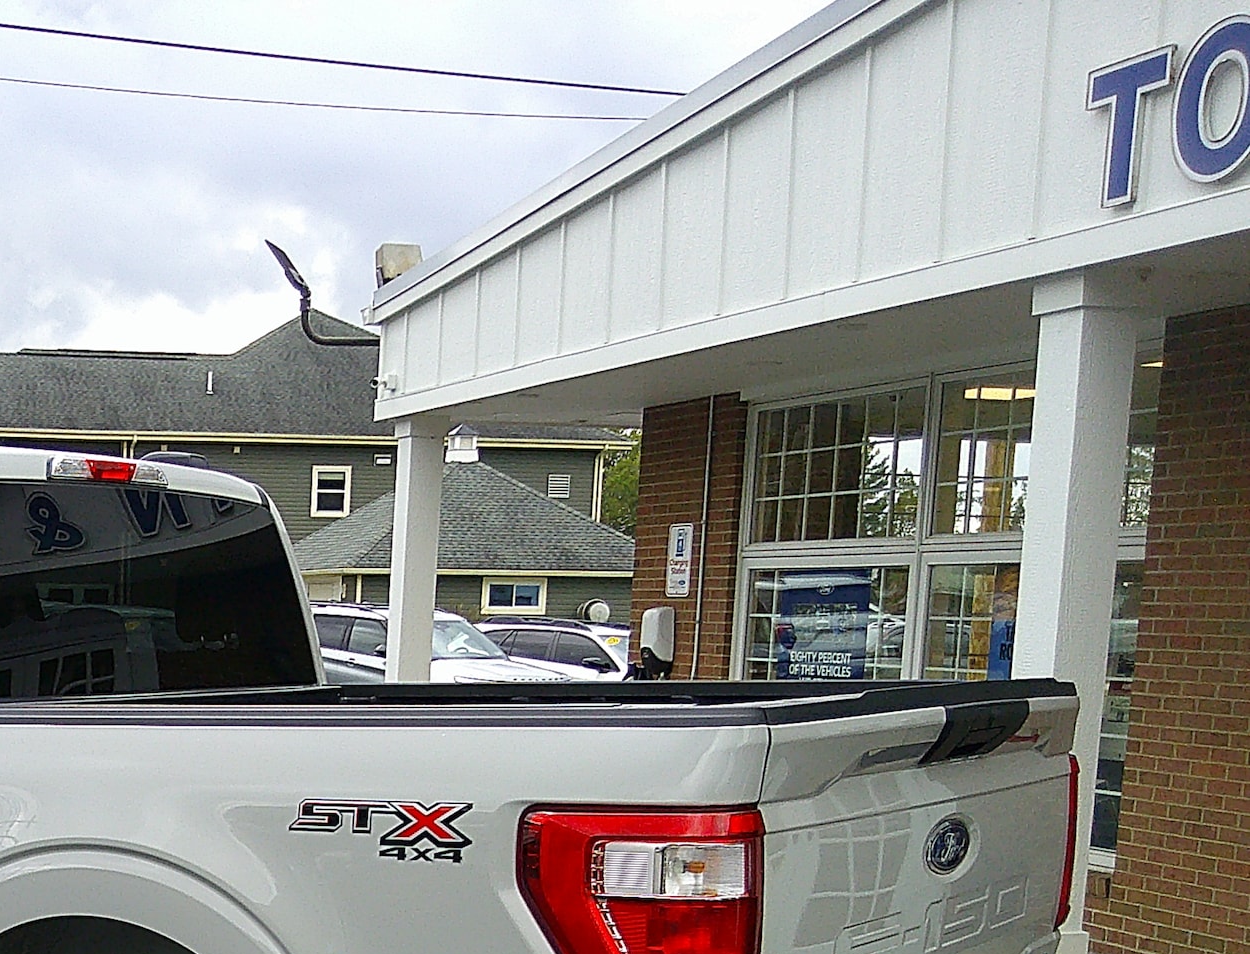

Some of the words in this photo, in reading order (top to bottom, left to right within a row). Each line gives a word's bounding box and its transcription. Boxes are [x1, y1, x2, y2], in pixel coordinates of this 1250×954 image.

[1086, 14, 1250, 208] TO
[789, 663, 799, 675] OF
[800, 664, 815, 676] THE
[816, 665, 852, 677] VEHICLES
[790, 651, 817, 662] EIGHTY
[818, 652, 852, 664] PERCENT
[288, 798, 473, 848] STX
